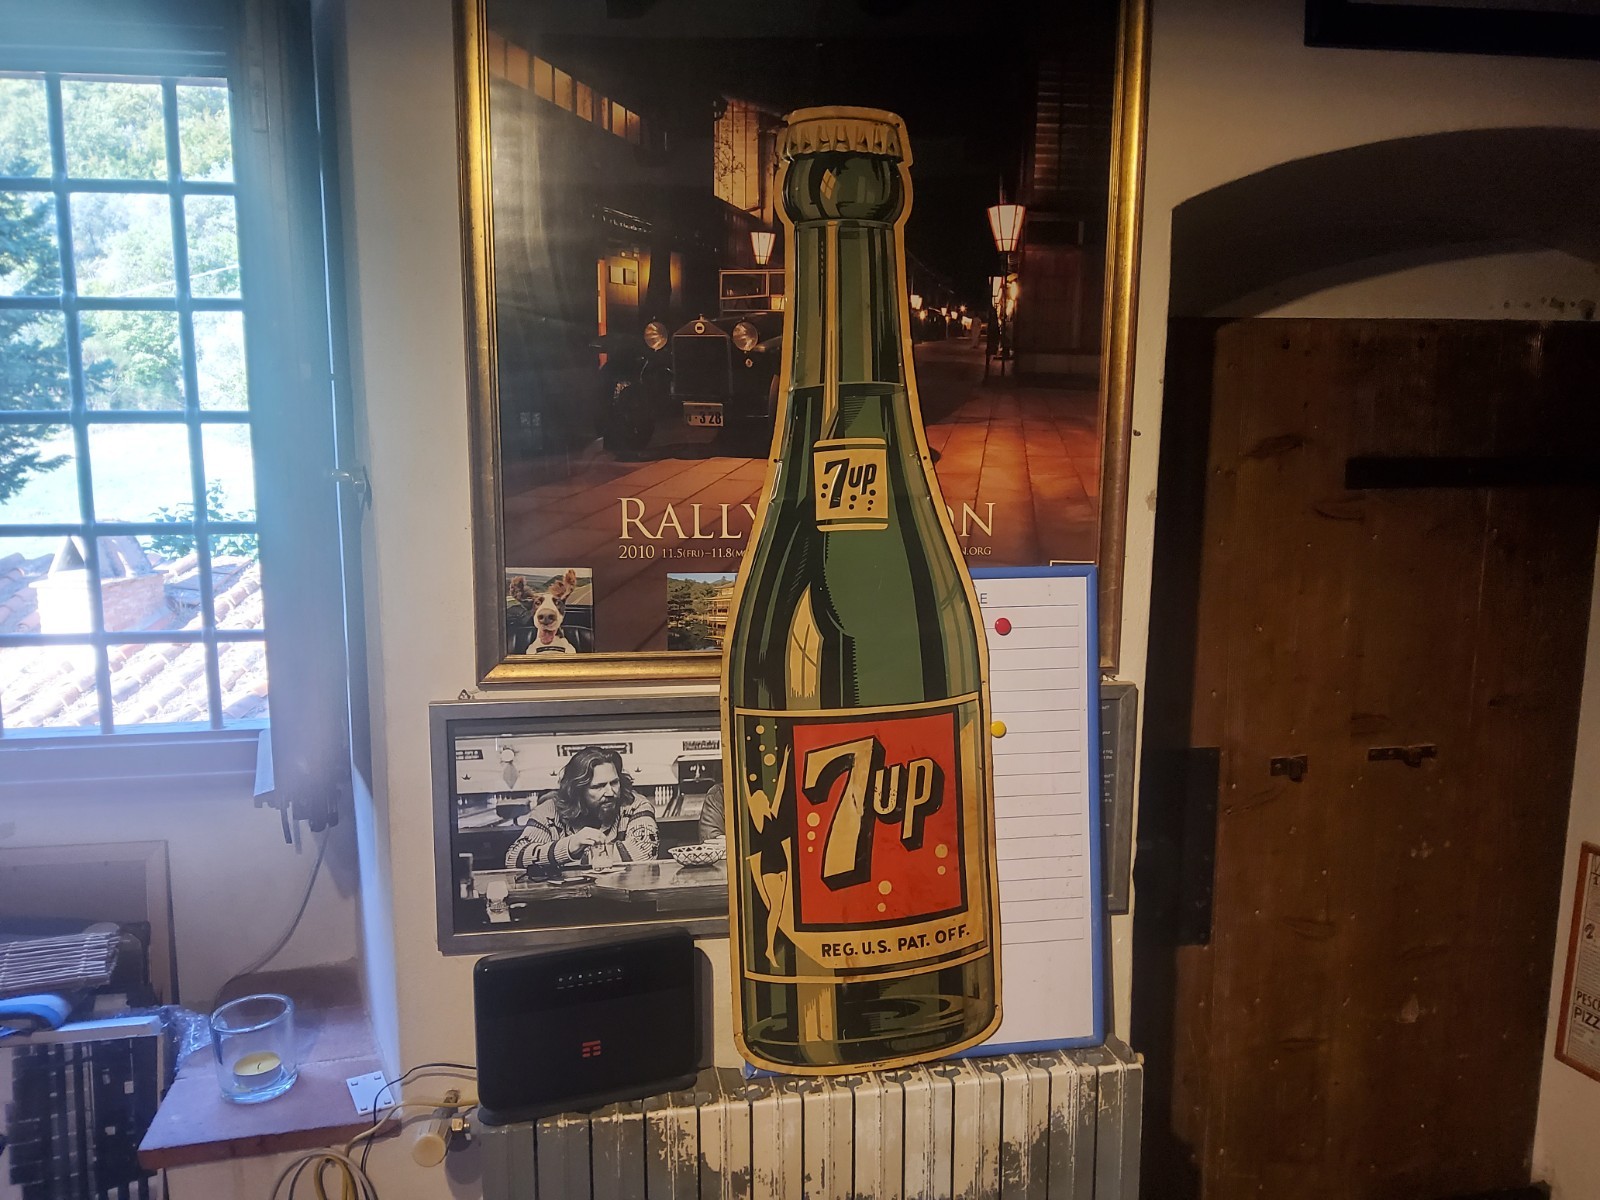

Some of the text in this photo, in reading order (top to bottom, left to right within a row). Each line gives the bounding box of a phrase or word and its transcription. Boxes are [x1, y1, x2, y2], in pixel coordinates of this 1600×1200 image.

[946, 502, 996, 538] N
[618, 544, 655, 559] 2010
[821, 942, 859, 958] REG.
[897, 933, 931, 952] PAT.
[934, 923, 970, 945] OFF.
